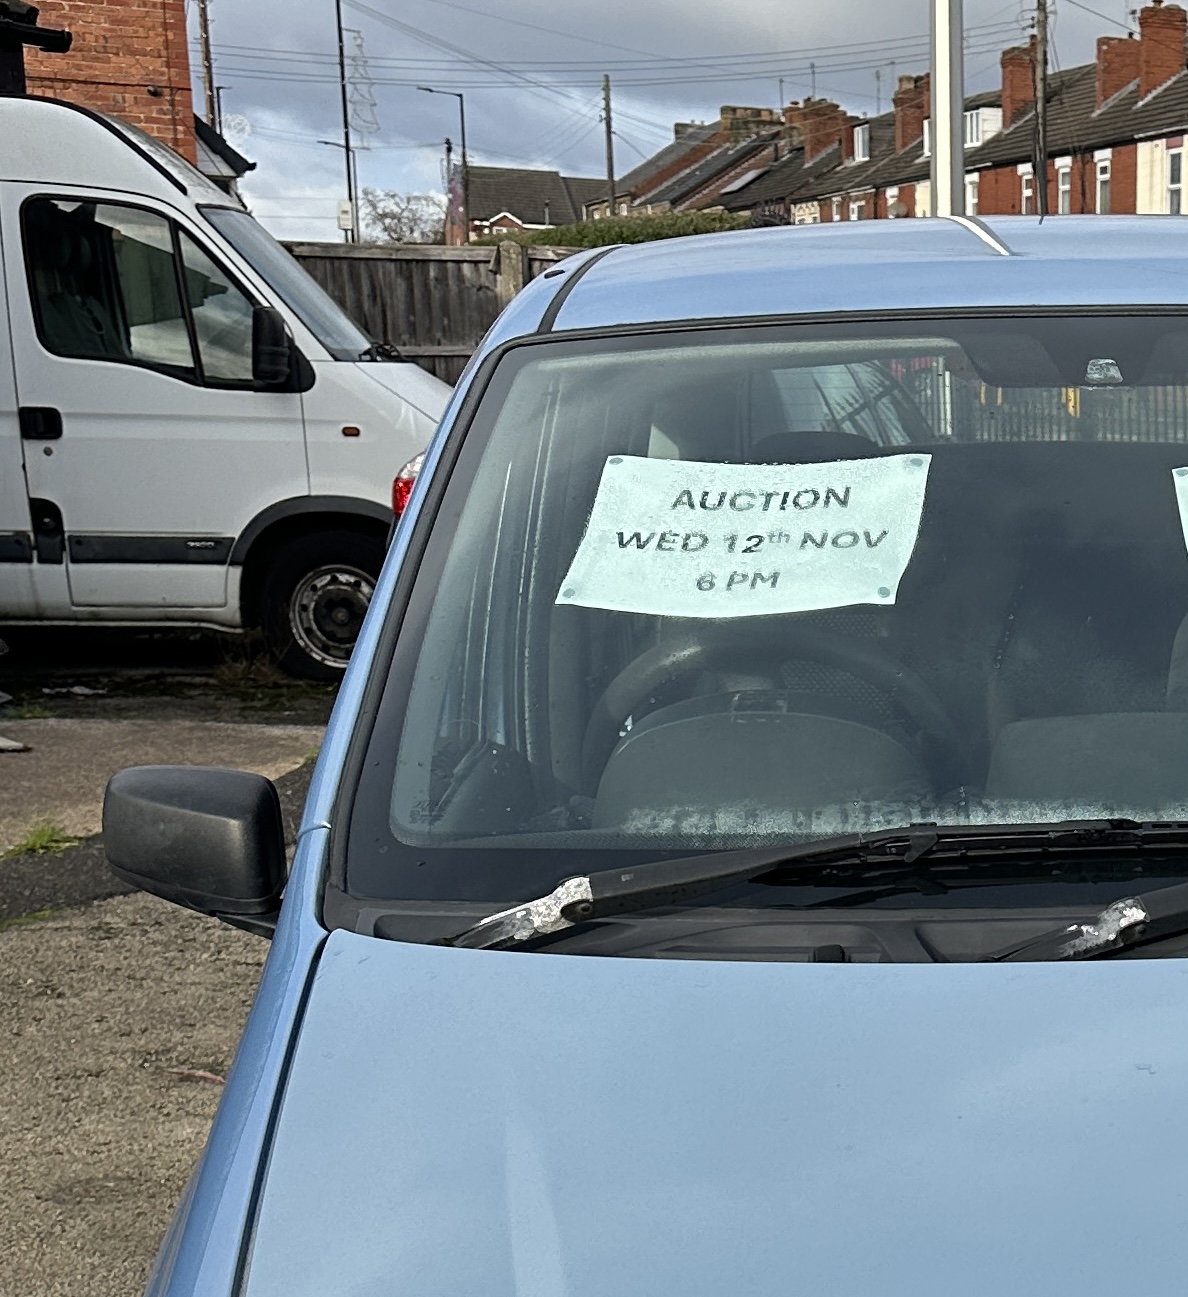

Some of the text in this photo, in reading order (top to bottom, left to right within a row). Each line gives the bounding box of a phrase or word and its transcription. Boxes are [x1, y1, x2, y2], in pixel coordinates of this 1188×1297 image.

[670, 486, 852, 512] AUCTION
[616, 529, 889, 553] WED 12th NOV
[696, 570, 781, 592] 6 PM
